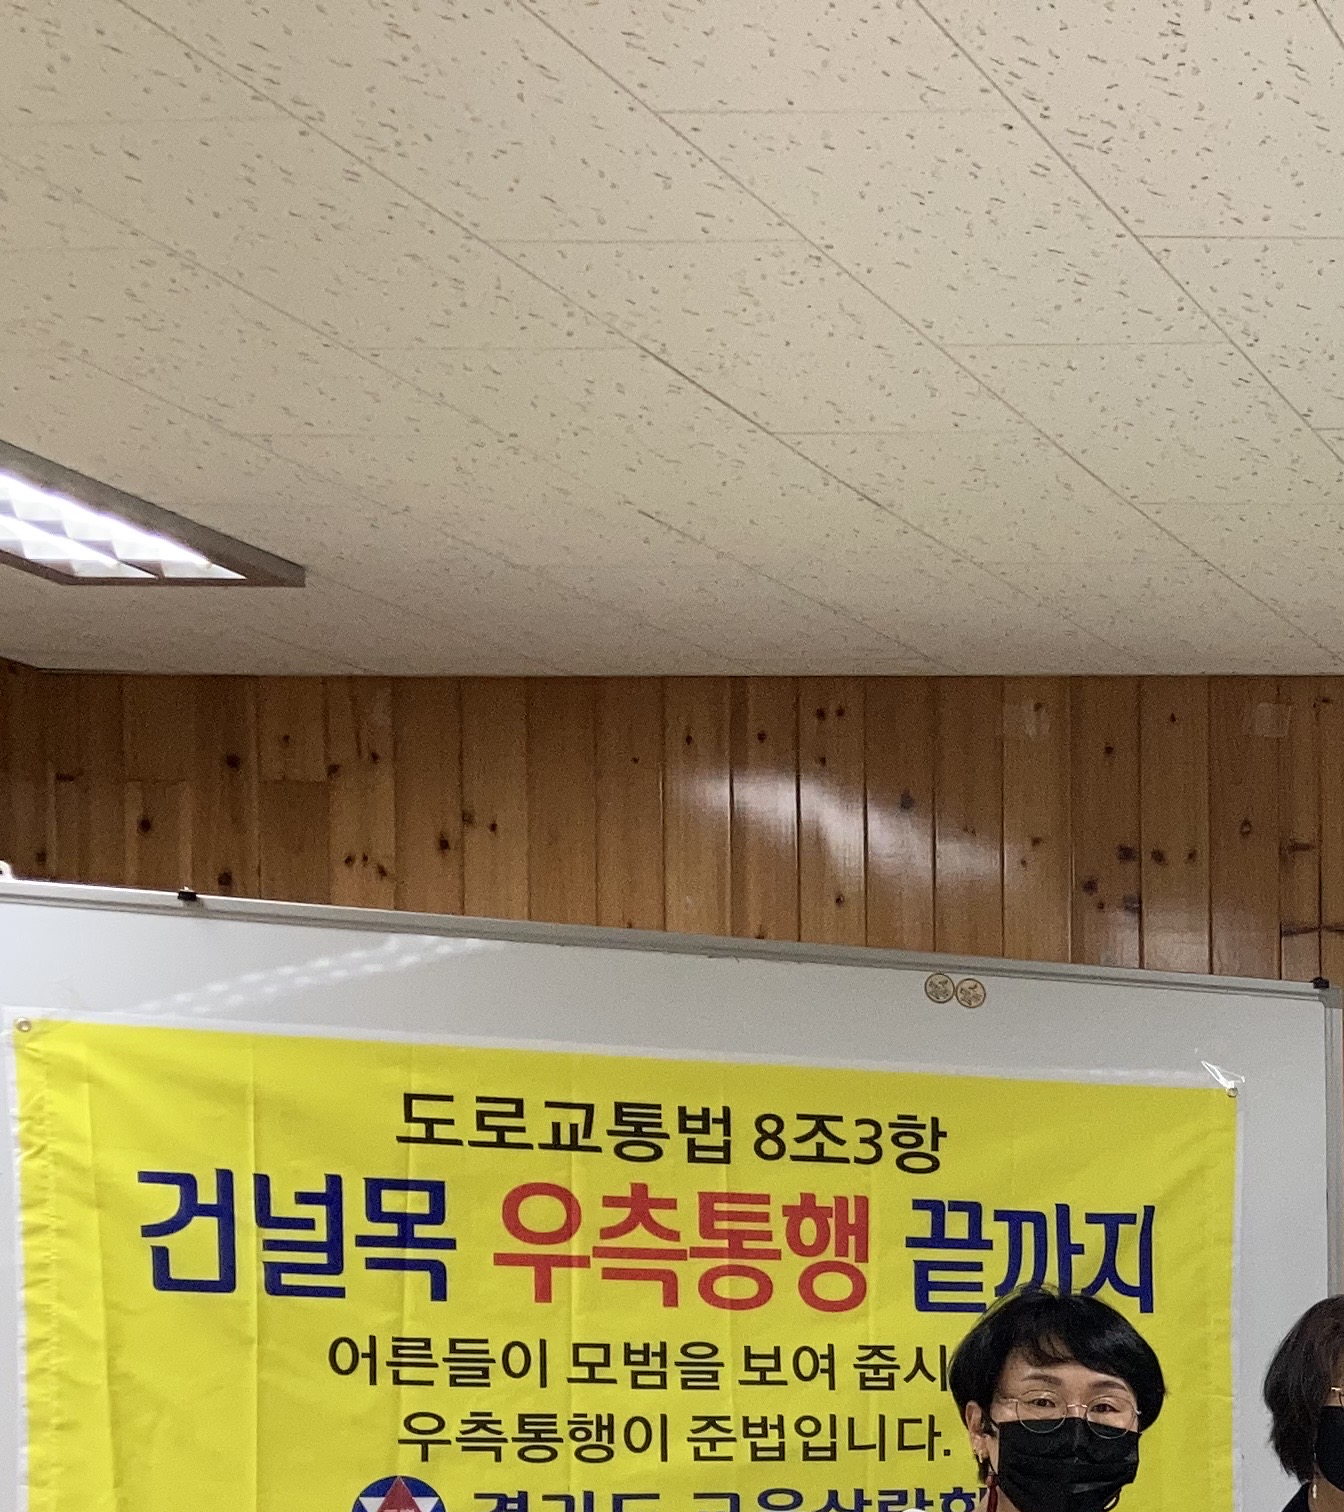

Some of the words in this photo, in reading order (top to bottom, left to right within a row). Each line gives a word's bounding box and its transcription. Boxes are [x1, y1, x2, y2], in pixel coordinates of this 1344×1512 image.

[396, 1092, 731, 1166] 도로교통법
[753, 1113, 948, 1174] 8조3항
[137, 1167, 457, 1302] 건널목
[493, 1181, 869, 1312] 우측통행
[905, 1199, 1155, 1313] 끝까지
[328, 1334, 548, 1389] 어른들이
[566, 1341, 725, 1391] 모범을
[738, 1344, 836, 1391] 보여
[852, 1344, 949, 1391] 줍시
[398, 1411, 669, 1463] 우측통행이
[687, 1414, 951, 1463] 준법입니다.
